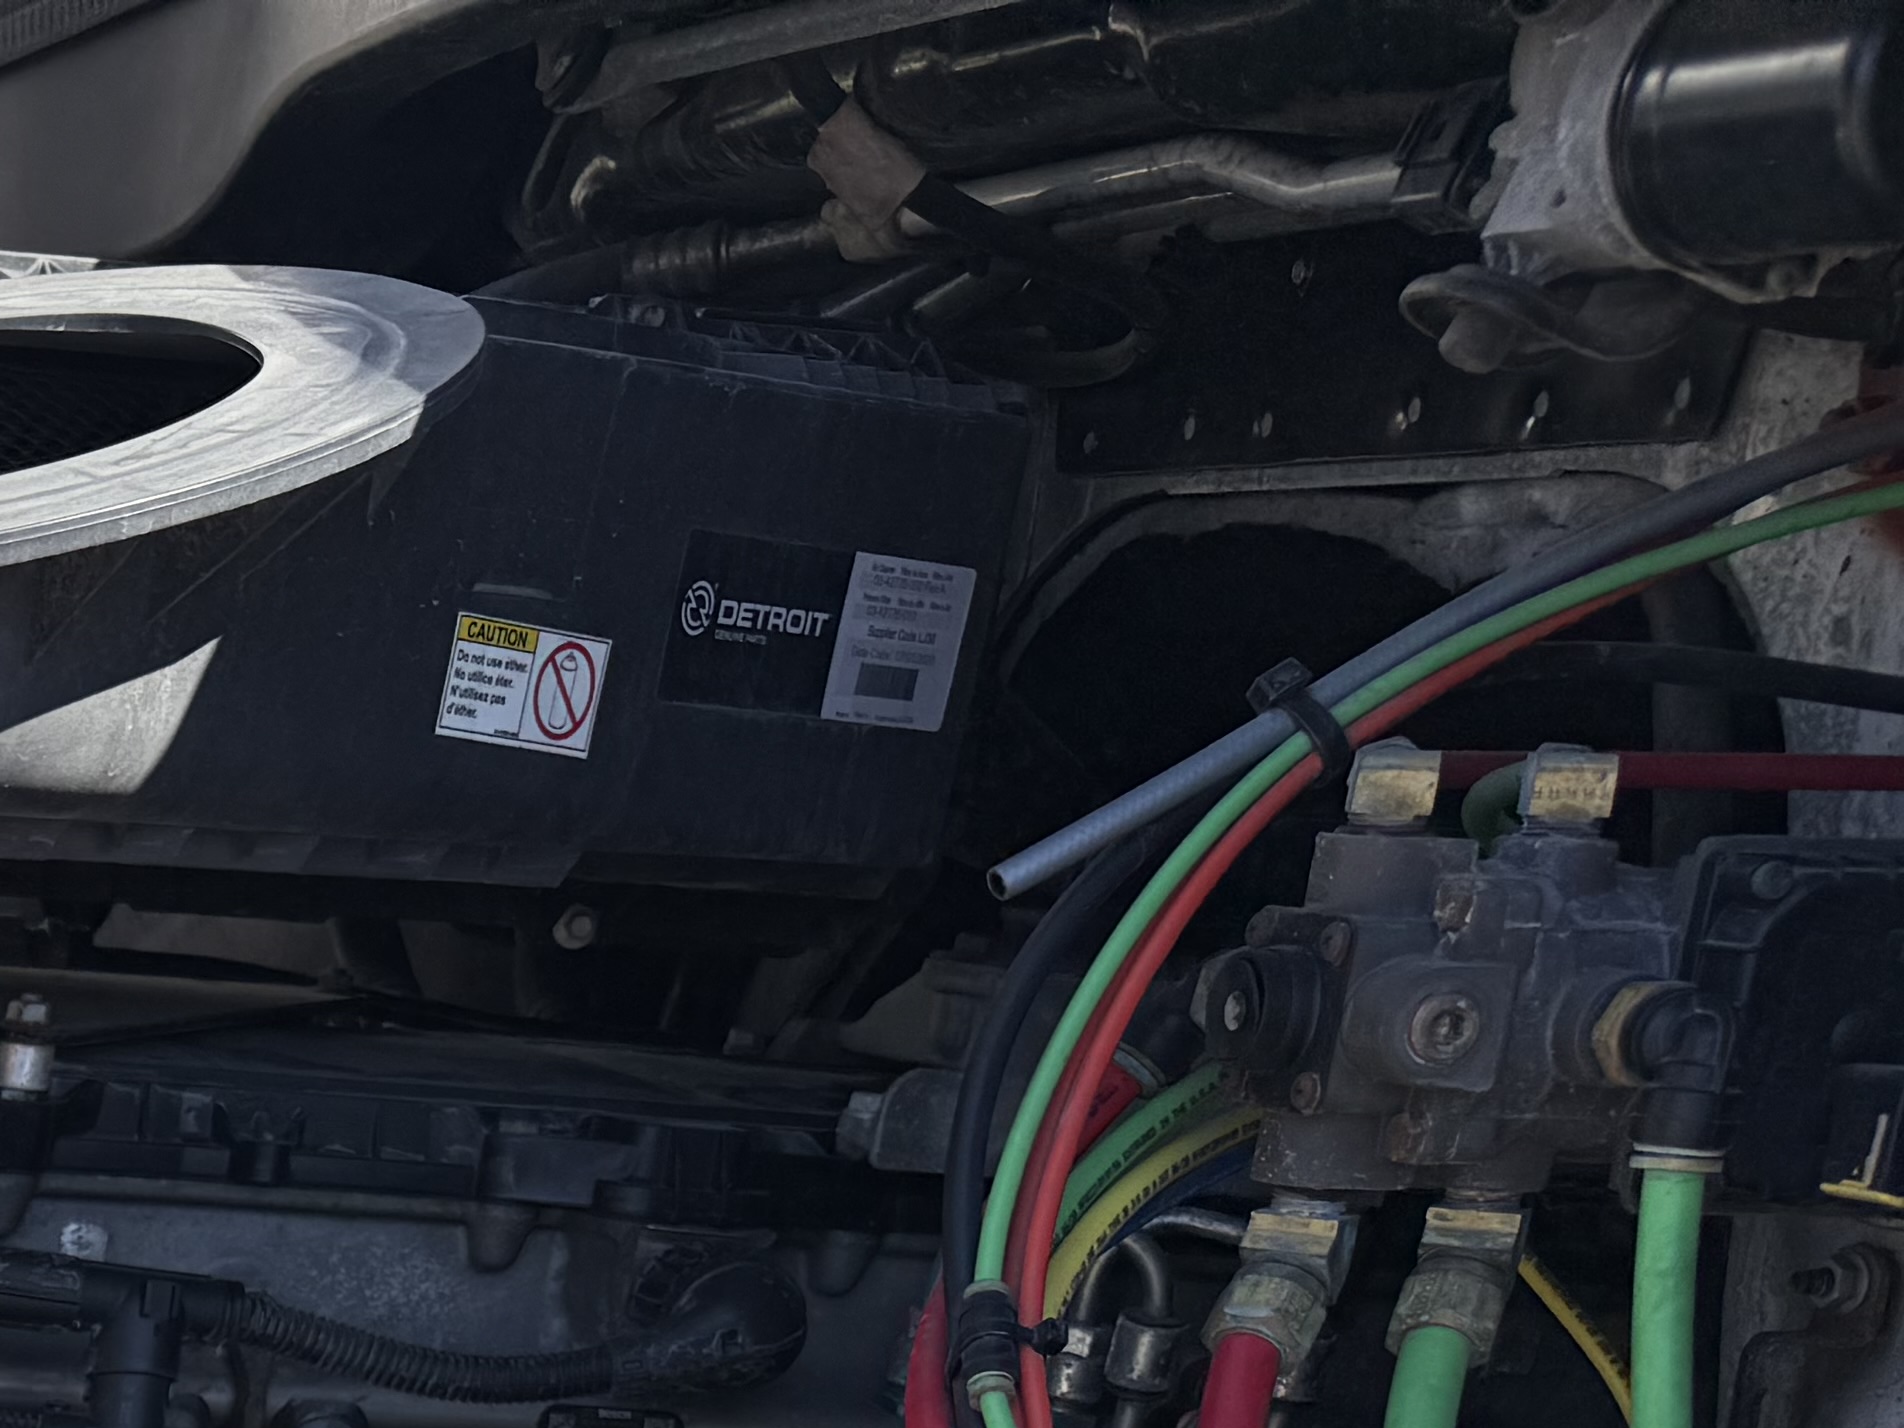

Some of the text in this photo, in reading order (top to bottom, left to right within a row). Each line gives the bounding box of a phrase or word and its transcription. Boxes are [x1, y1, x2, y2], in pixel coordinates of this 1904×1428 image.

[717, 599, 831, 637] DETROIT
[468, 622, 529, 649] CAUTION
[457, 649, 469, 662] Do
[471, 653, 485, 665] not
[487, 657, 503, 667] use
[454, 667, 465, 680] No
